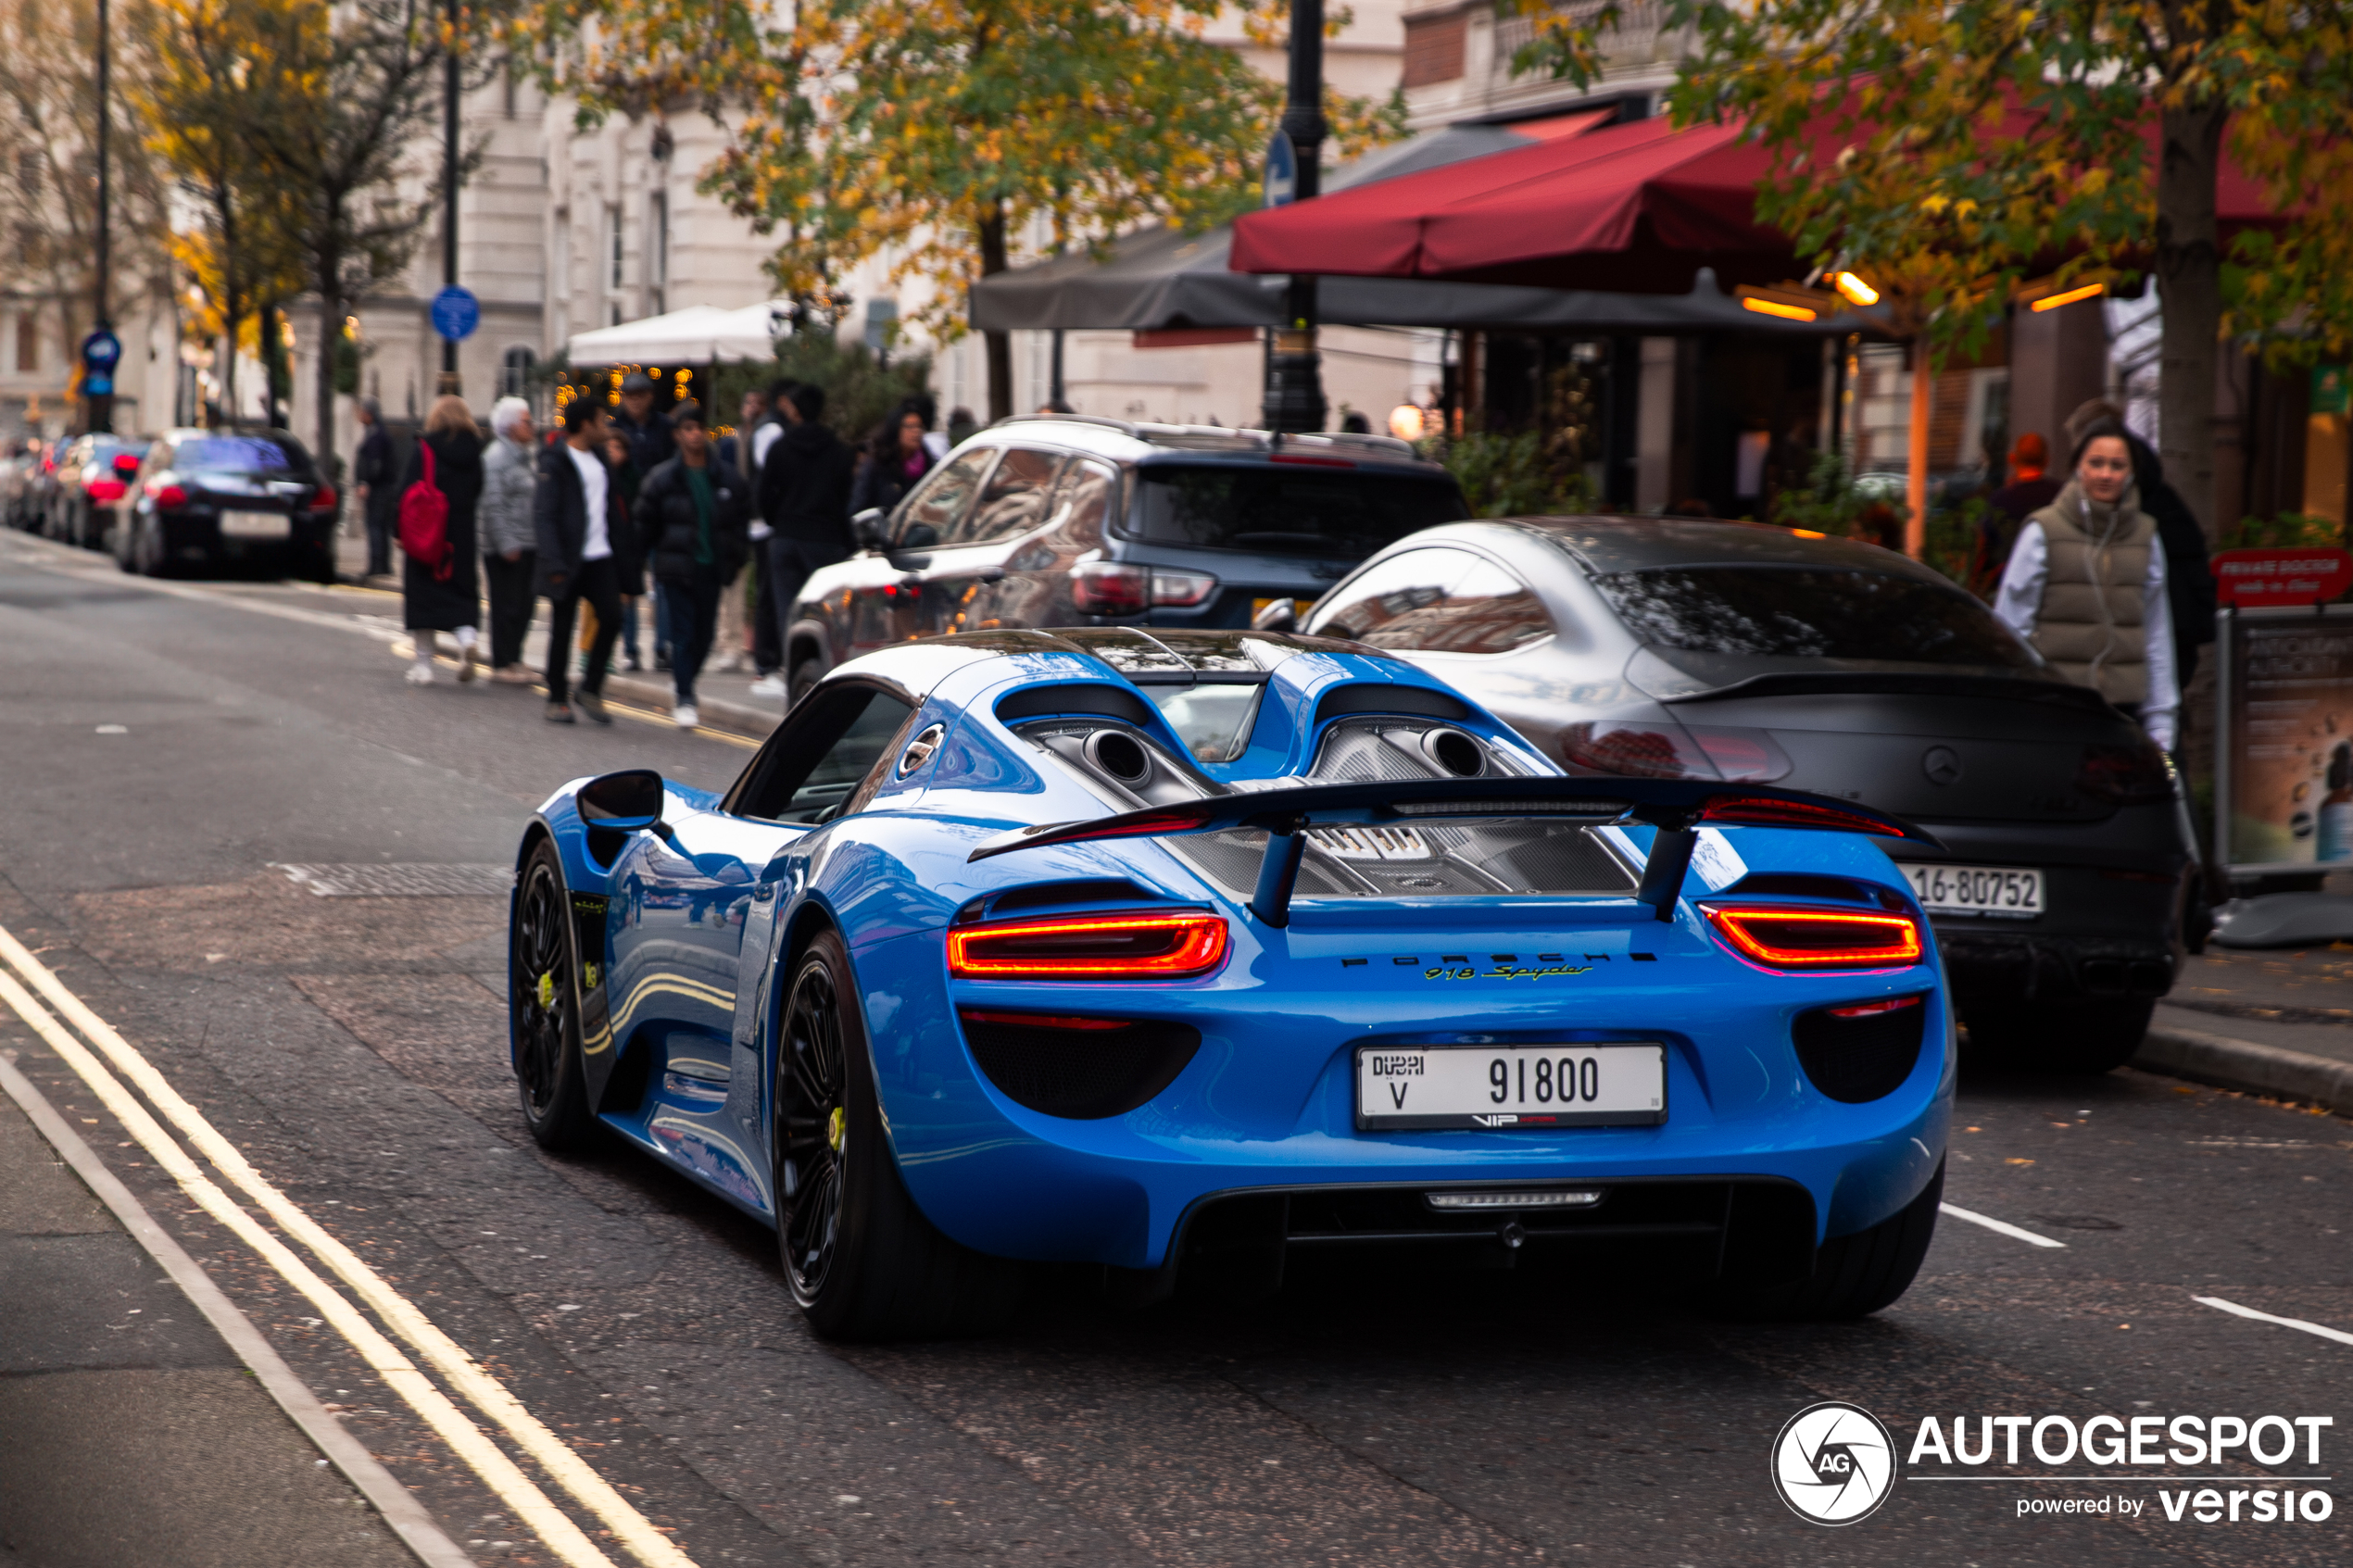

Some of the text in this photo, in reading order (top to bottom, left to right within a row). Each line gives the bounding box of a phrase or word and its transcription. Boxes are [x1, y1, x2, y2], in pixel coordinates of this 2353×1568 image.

[2278, 558, 2339, 574] DOCTOR
[1915, 868, 2037, 907] 16-80752
[1341, 952, 1657, 968] PORSCHE
[1424, 964, 1593, 981] 918 Spyder
[1490, 1057, 1598, 1103] 91800
[1390, 1082, 1408, 1110] V
[1472, 1114, 1518, 1127] VIP
